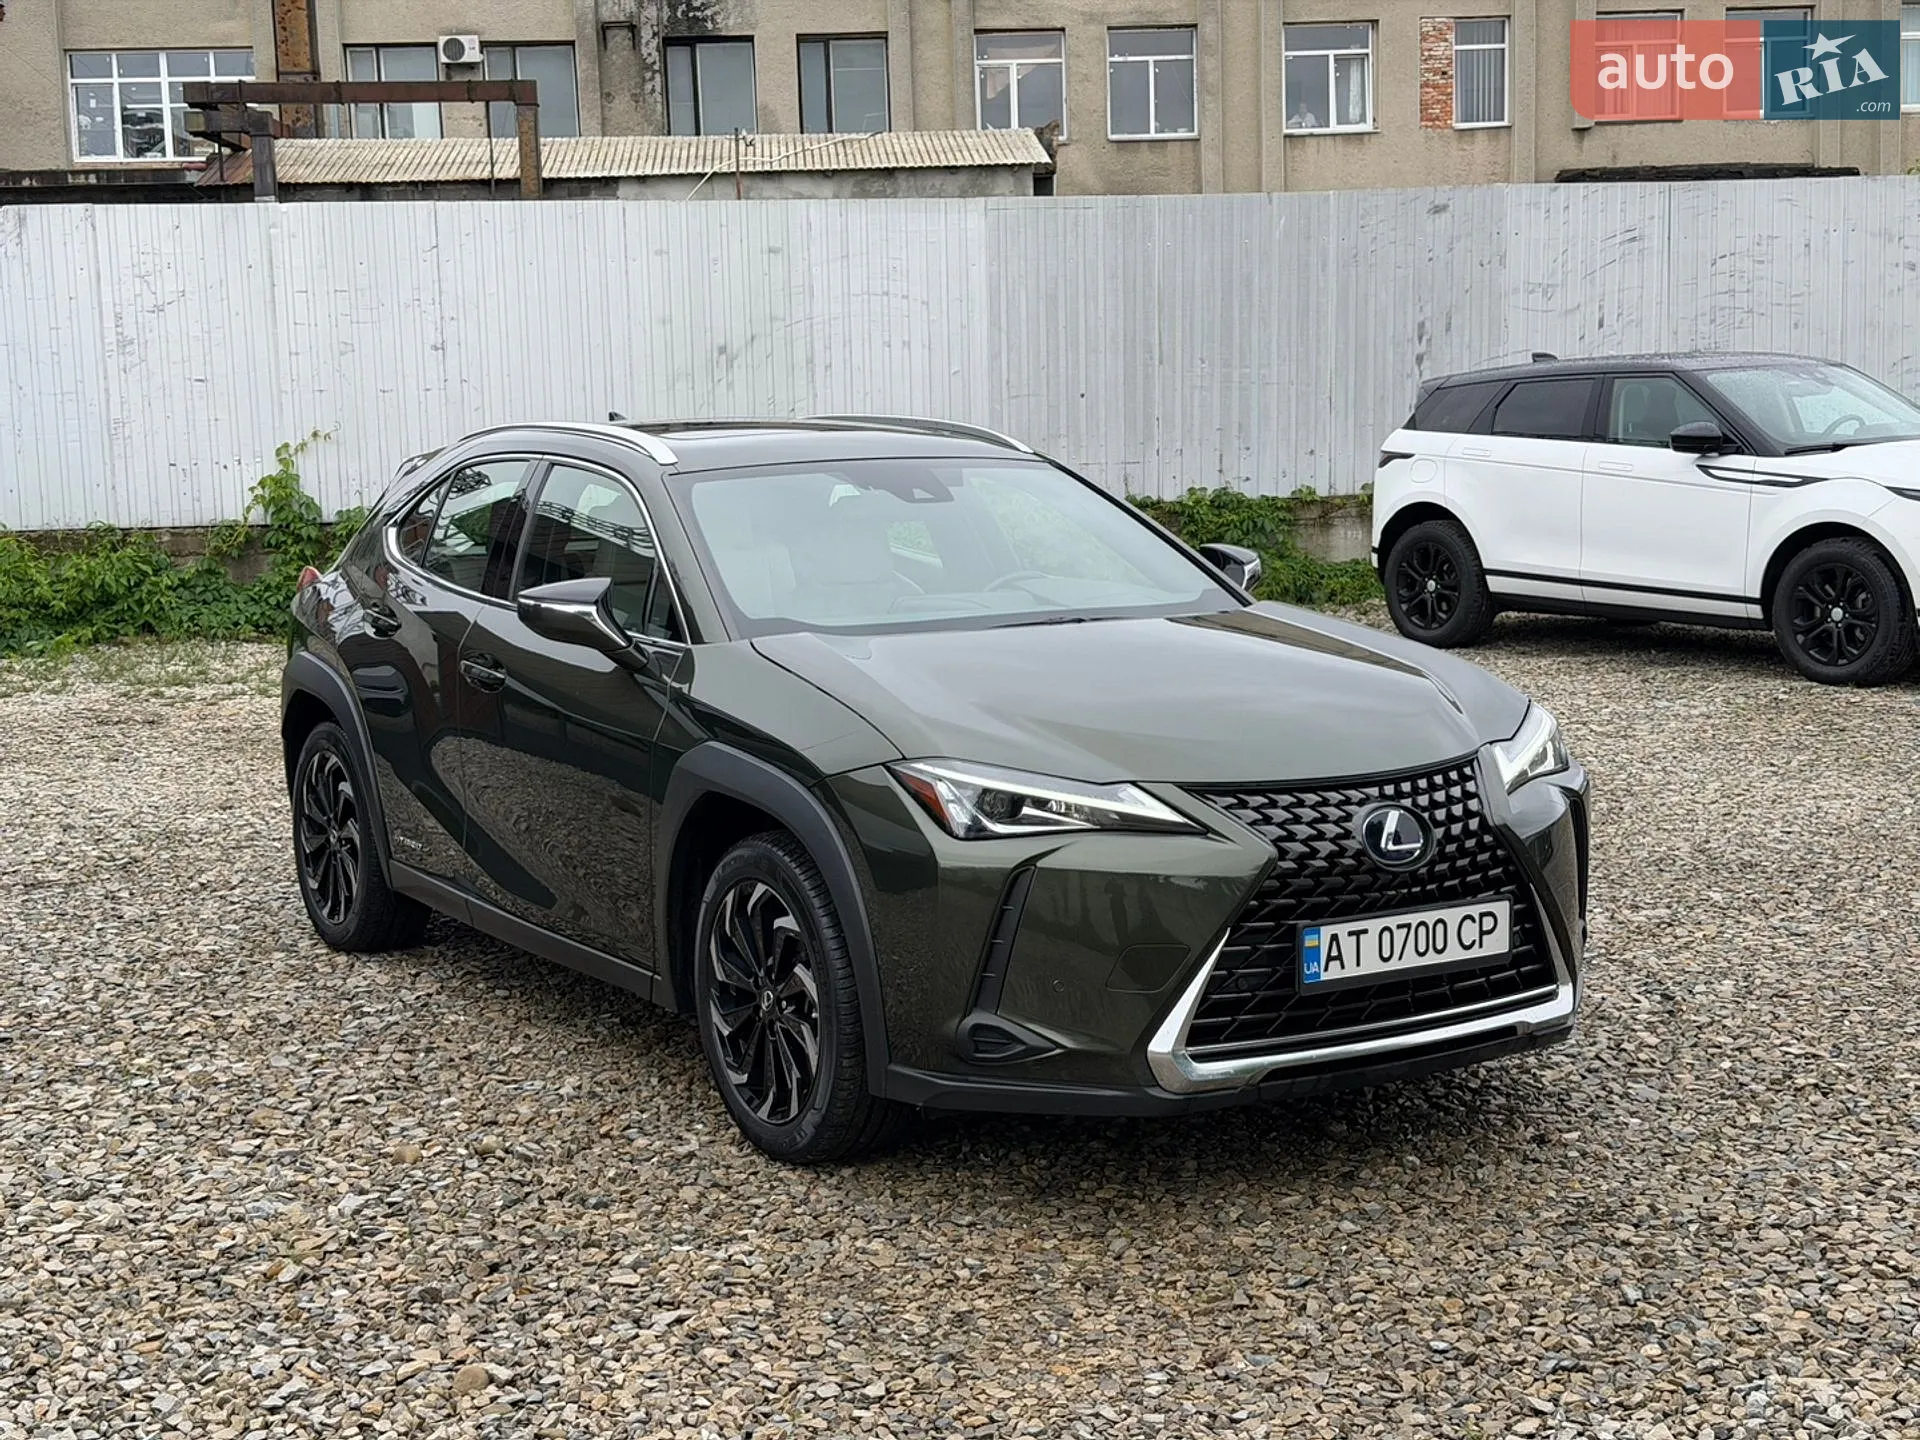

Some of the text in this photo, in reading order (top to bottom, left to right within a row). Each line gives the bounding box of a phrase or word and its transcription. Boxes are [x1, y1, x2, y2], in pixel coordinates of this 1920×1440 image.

[1323, 910, 1499, 972] AT 0700 CP
[1303, 962, 1320, 975] UA
